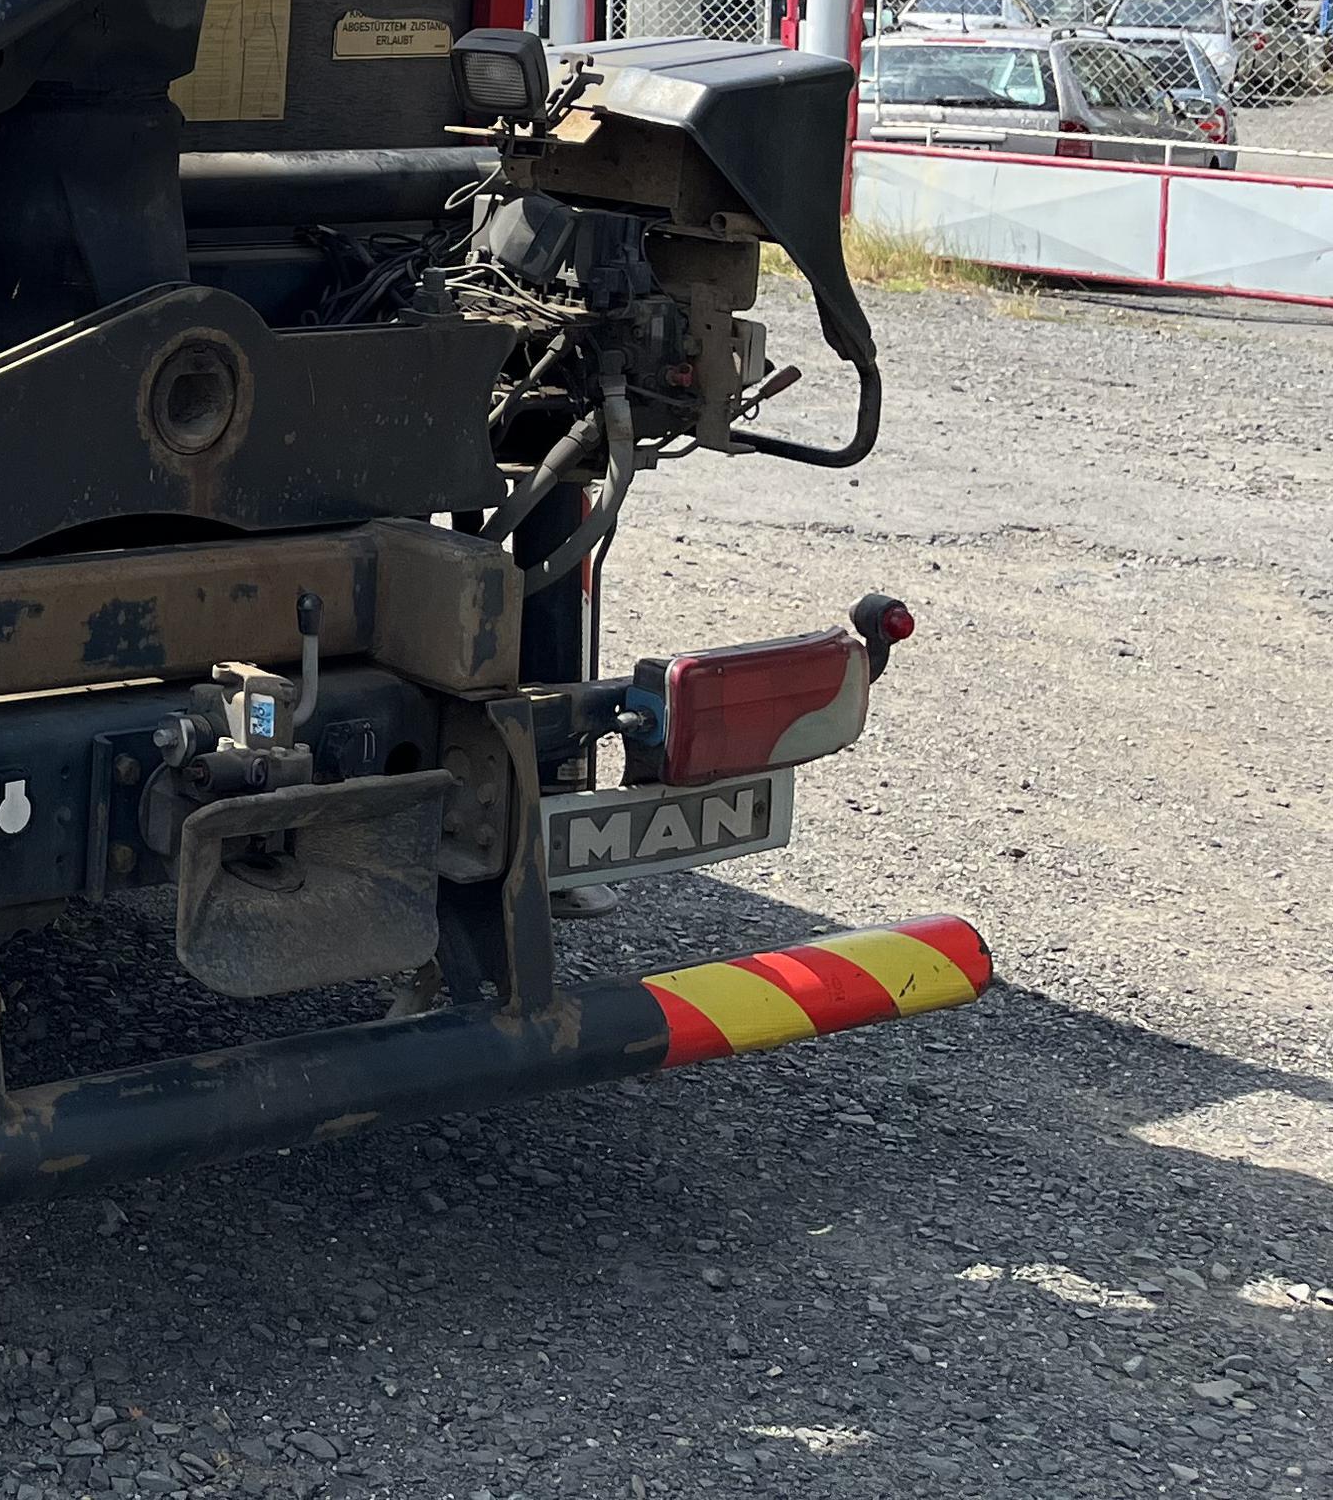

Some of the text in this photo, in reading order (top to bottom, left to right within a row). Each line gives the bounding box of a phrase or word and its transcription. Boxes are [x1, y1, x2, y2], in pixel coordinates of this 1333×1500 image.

[342, 19, 407, 32] ABGESTÜTZTEM
[376, 35, 414, 46] ERLAUBT
[569, 789, 755, 868] MAN
